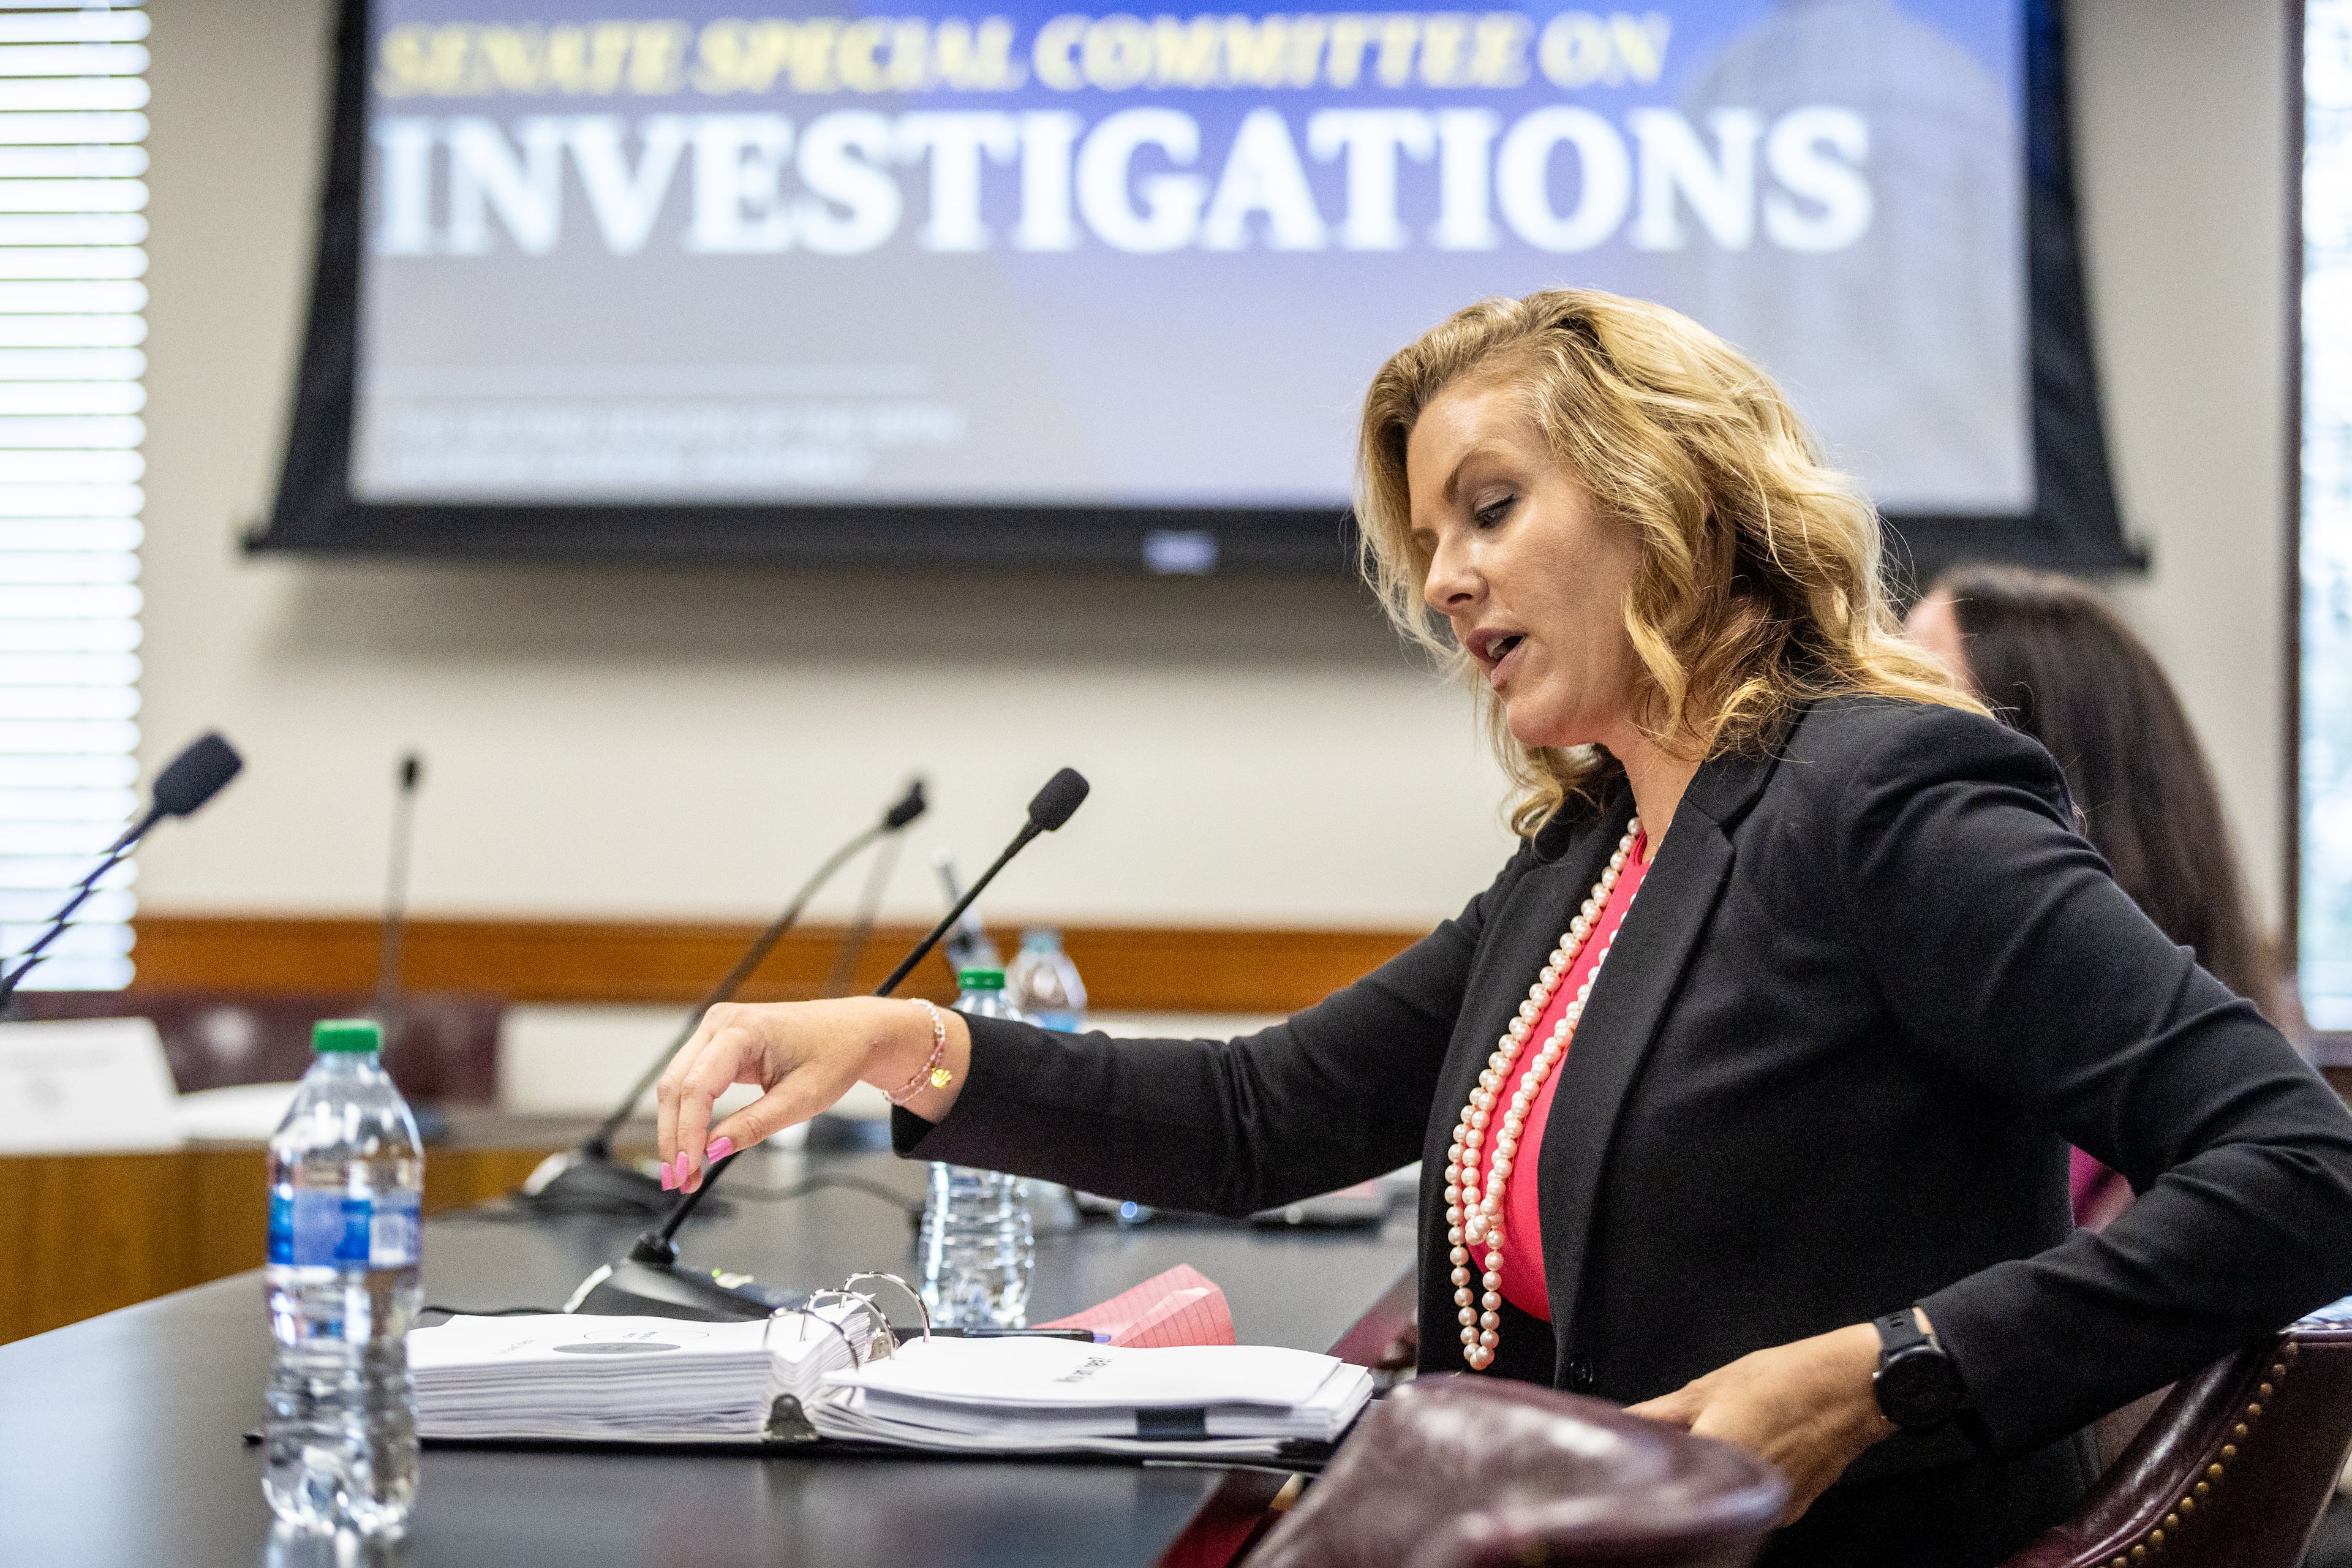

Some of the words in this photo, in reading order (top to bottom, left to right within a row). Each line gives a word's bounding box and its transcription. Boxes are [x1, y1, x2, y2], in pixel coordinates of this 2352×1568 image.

[376, 20, 690, 97] SENATE
[693, 16, 1030, 93] SPECIAL
[1033, 11, 1532, 91] COMMITTEE
[1537, 11, 1670, 89] ON
[379, 107, 1873, 254] INVESTIGATIONS
